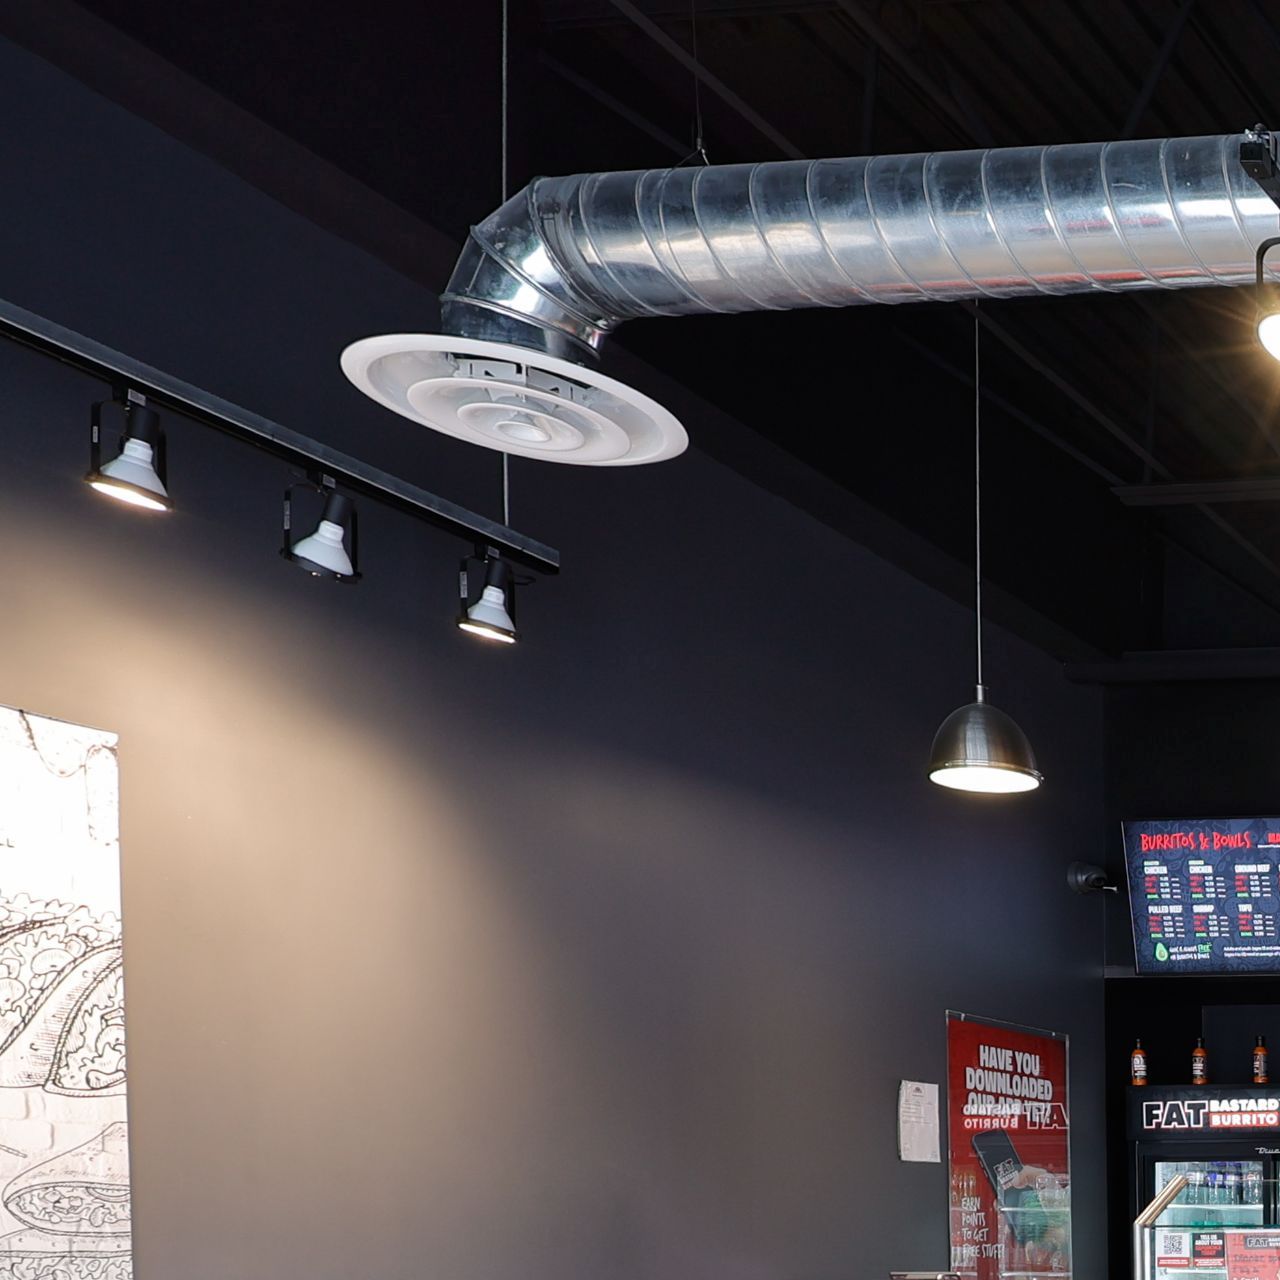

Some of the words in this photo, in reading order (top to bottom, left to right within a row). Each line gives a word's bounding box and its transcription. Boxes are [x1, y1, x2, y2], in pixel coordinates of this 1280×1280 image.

[1140, 833, 1196, 851] BURRITOS
[1213, 832, 1250, 850] BOWLS
[979, 1045, 1013, 1072] HAVE
[1015, 1051, 1040, 1076] YOU
[966, 1067, 1052, 1100] DOWNLOADED
[1143, 1100, 1208, 1129] FAT
[1210, 1098, 1280, 1112] BASTARD
[1212, 1114, 1278, 1126] BURRITO
[962, 1196, 980, 1212] EARN
[962, 1212, 986, 1226] POINTS
[962, 1228, 972, 1240] TO
[973, 1228, 988, 1242] GET
[1247, 1238, 1268, 1248] FAT
[962, 1244, 980, 1258] FREE
